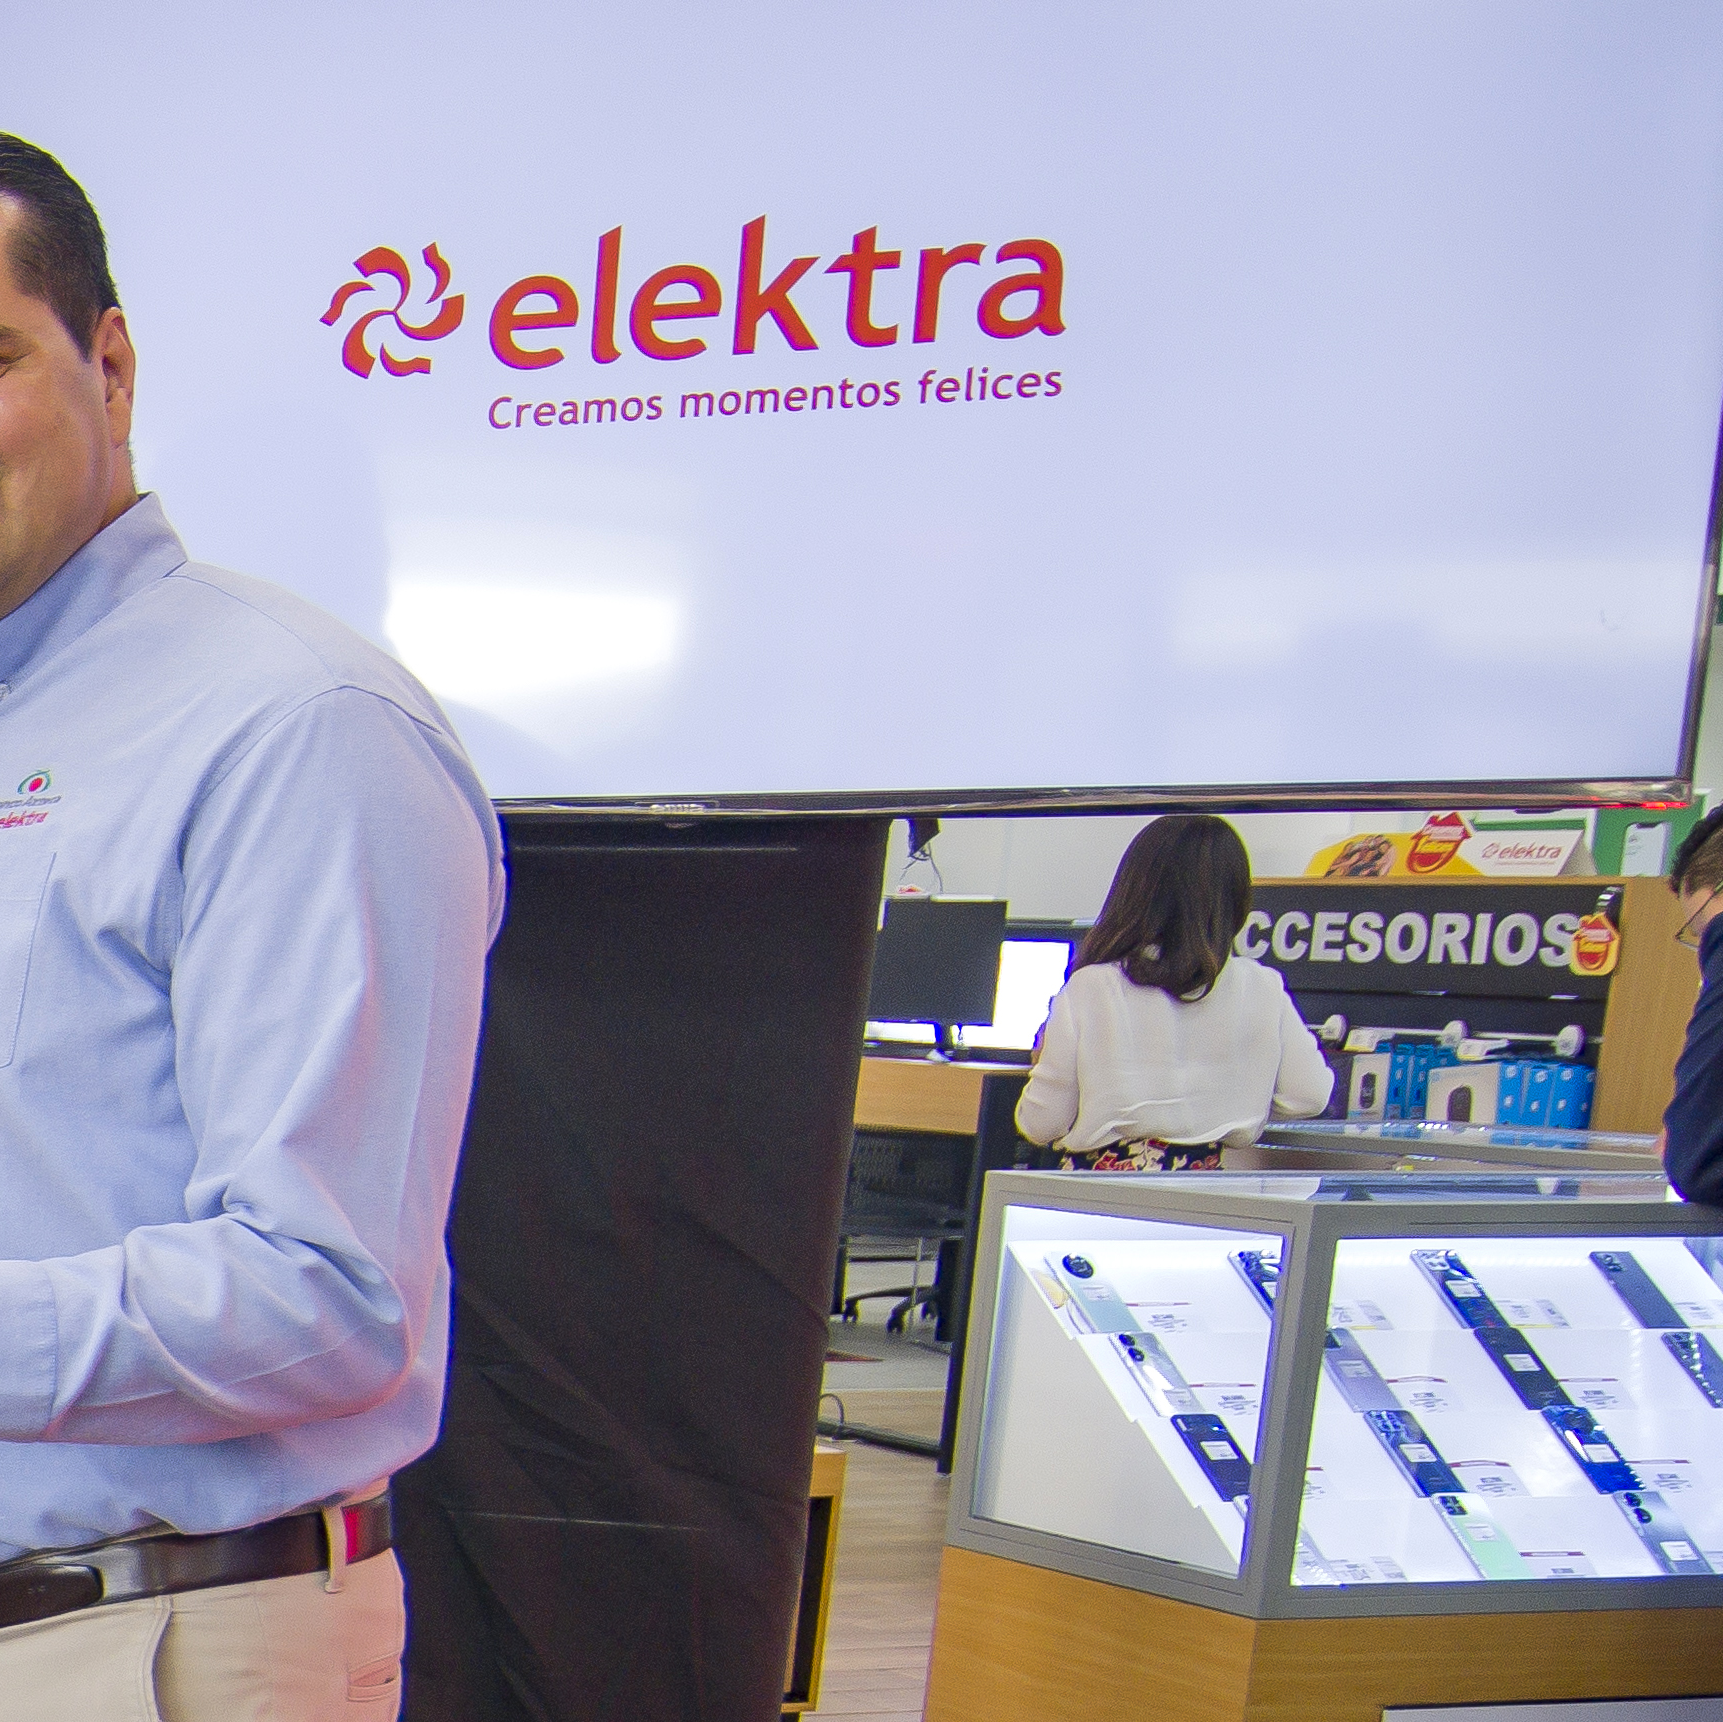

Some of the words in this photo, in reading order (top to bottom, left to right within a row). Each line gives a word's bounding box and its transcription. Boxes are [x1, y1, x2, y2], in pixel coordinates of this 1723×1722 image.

[487, 214, 1067, 370] elektra
[487, 396, 663, 429] Creamos
[679, 378, 901, 418] momentos
[917, 367, 1063, 405] felices
[1497, 842, 1563, 860] elektra
[1235, 910, 1580, 968] CCESORIOS
